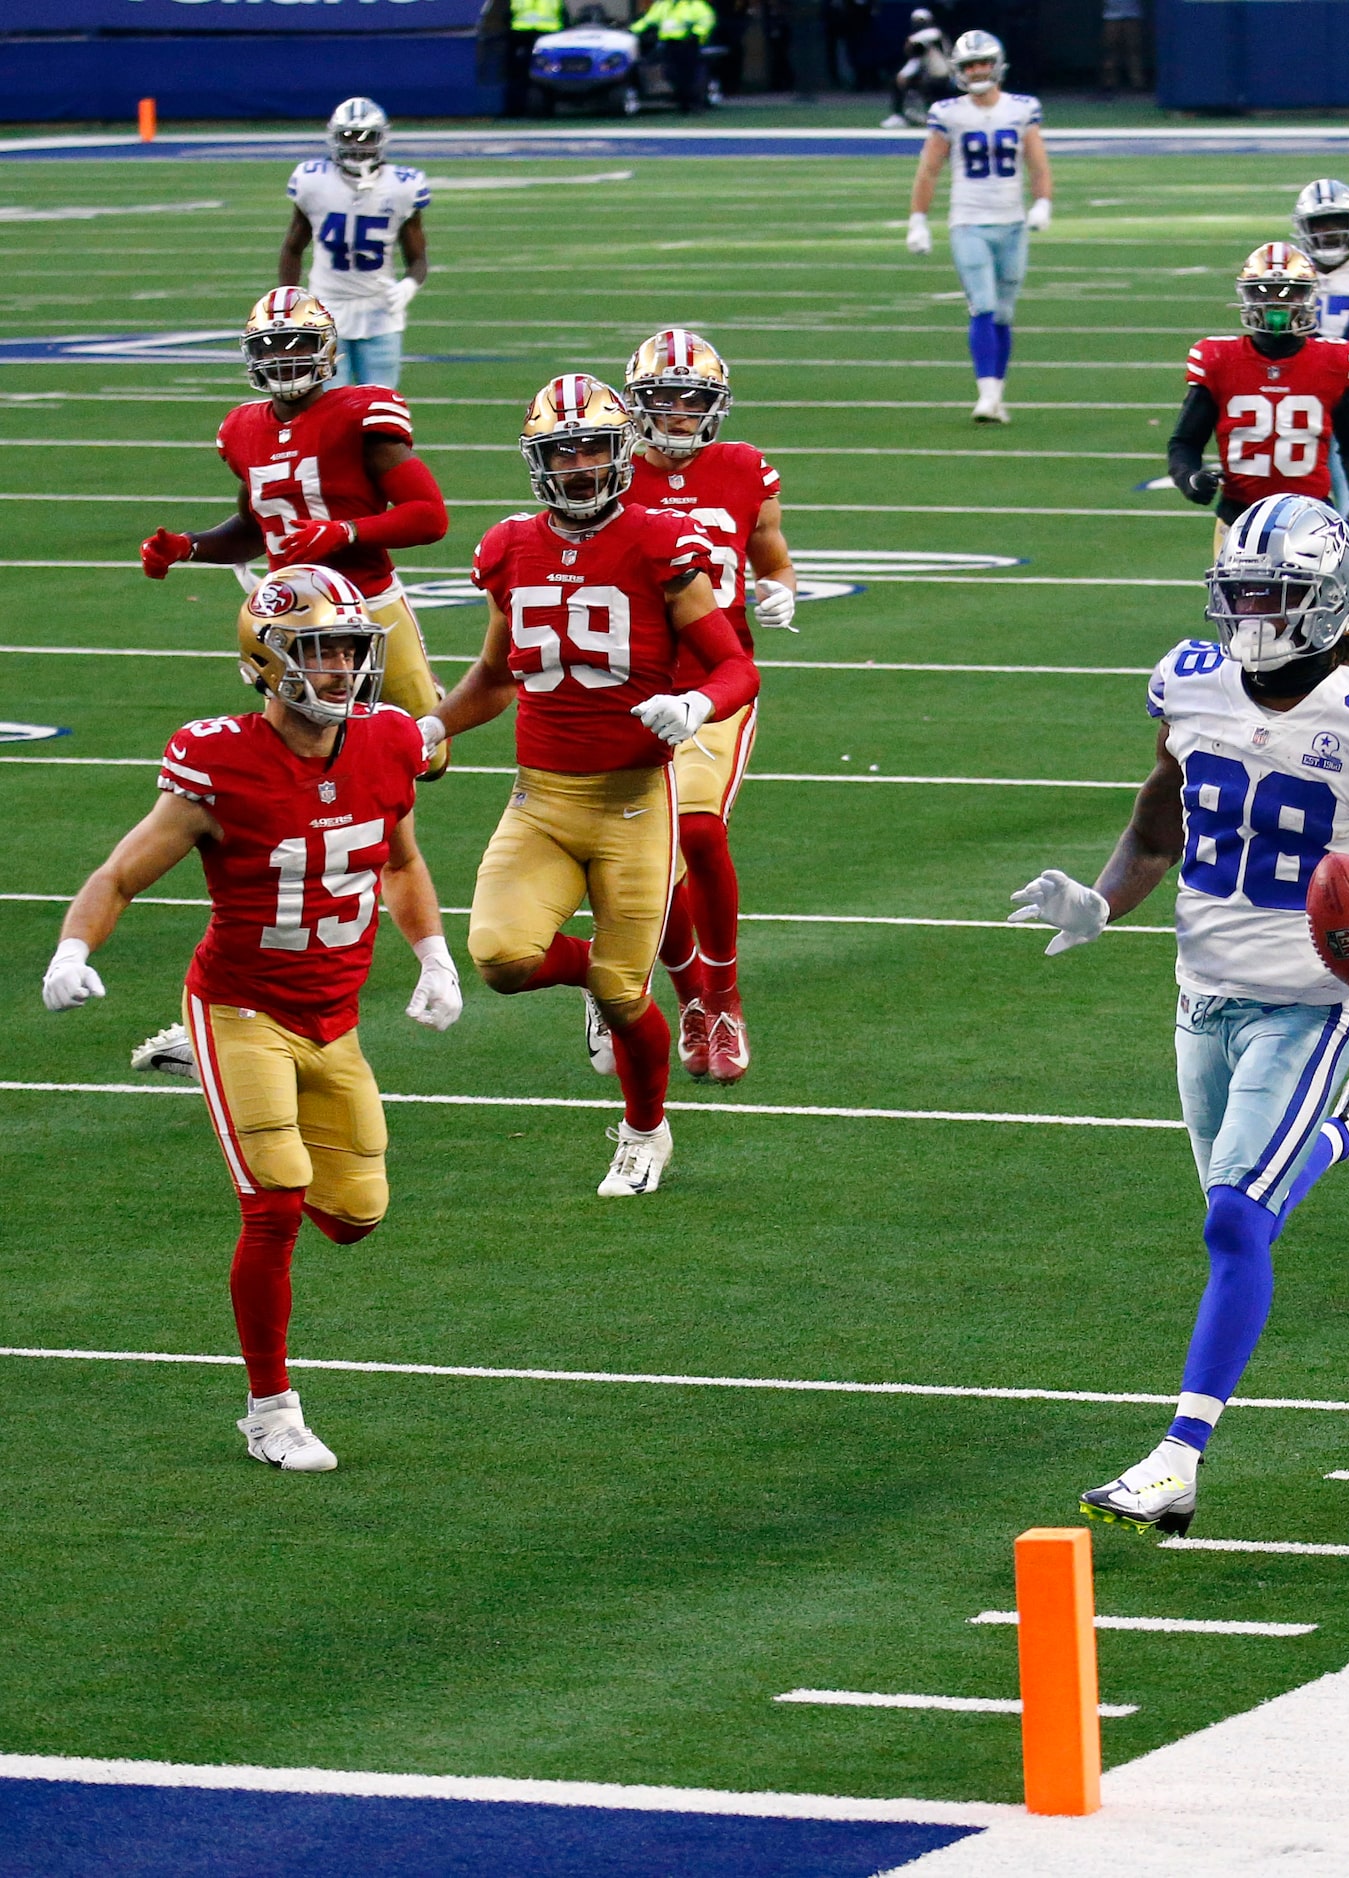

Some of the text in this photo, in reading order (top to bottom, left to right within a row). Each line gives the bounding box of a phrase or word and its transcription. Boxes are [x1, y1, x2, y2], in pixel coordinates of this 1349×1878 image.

[962, 129, 1018, 178] 86
[320, 212, 390, 271] 45
[1227, 395, 1323, 477] 28
[248, 456, 331, 555] 51
[546, 573, 585, 583] 49ERS
[687, 508, 738, 608] 6
[508, 586, 630, 692] 59
[309, 814, 353, 828] 49ERS
[1181, 750, 1338, 910] 88
[260, 818, 384, 951] 15
